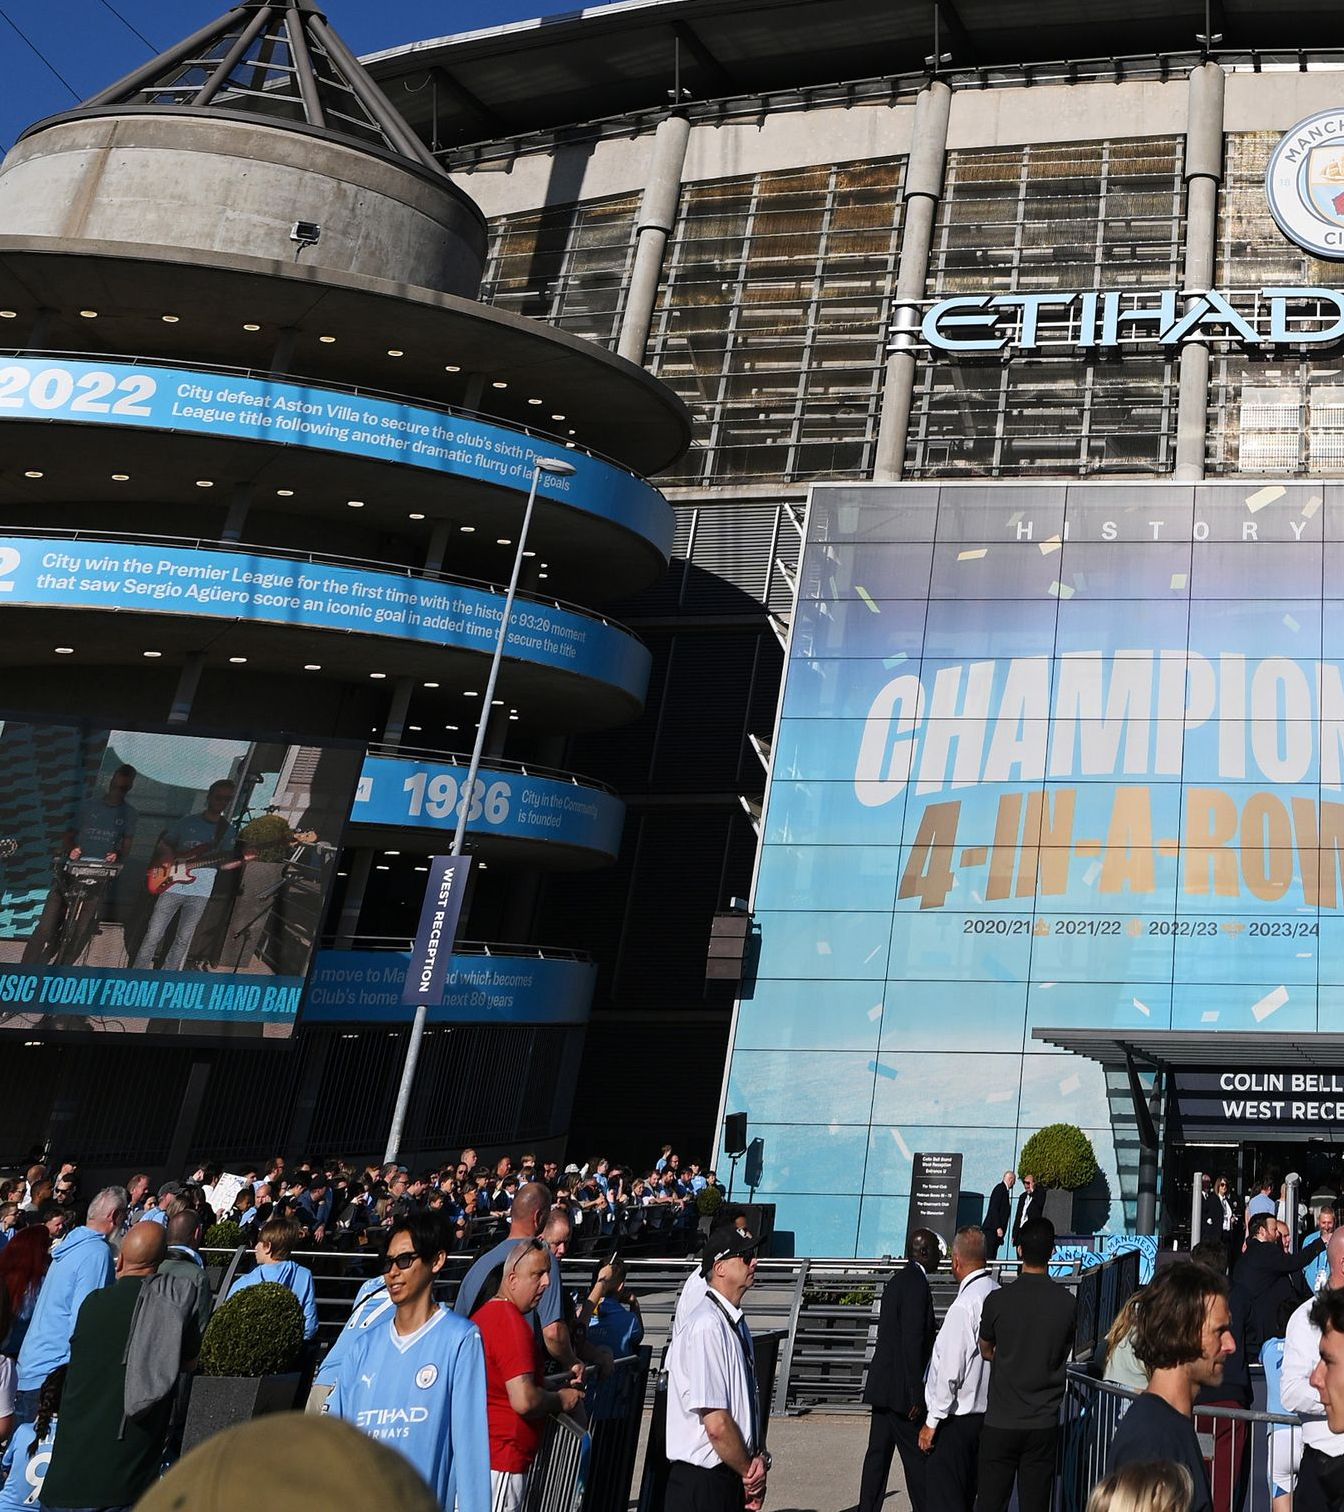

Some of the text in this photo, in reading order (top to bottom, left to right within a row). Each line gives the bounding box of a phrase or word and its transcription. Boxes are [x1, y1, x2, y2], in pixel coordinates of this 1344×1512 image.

[0, 366, 157, 417] 2022
[177, 383, 213, 403] City
[216, 388, 272, 408] defeat
[273, 395, 323, 416] Aston
[325, 402, 360, 422] Villa
[362, 411, 378, 426] to
[380, 417, 430, 436] secure
[431, 425, 455, 442] the
[456, 431, 493, 451] club's
[494, 440, 524, 460] sixth
[172, 402, 237, 423] League
[239, 409, 272, 428] title
[275, 416, 349, 442] following
[350, 430, 411, 451] another
[412, 439, 474, 465] dramatic
[474, 453, 508, 476] flurry
[509, 462, 523, 477] of
[543, 474, 571, 493] goals
[1016, 519, 1309, 541] HISTORY
[42, 552, 587, 643] City win the Premier League for the first time with the histoic 93:20 moment
[36, 573, 577, 659] that saw Sergio Agüero score an iconic goal in added time secure the title
[403, 772, 512, 825] 1986
[522, 789, 541, 808] City
[528, 810, 562, 828] founded
[437, 867, 455, 908] WEST
[963, 919, 1320, 938] 2020/21 2021/22 2022/23 2023/24
[418, 911, 446, 993] RECEPTION
[319, 969, 363, 984] move
[460, 970, 491, 986] which
[492, 971, 533, 988] becomes
[39, 977, 102, 1006] TODAY
[100, 979, 160, 1008] FROM
[159, 983, 205, 1010] PAUL
[208, 984, 262, 1012] HAND
[312, 988, 514, 1010] Club's home next years
[1220, 1073, 1284, 1093] COLIN
[1291, 1074, 1344, 1093] BELL
[1222, 1101, 1285, 1120] WEST
[355, 1407, 429, 1427] ETIHAD
